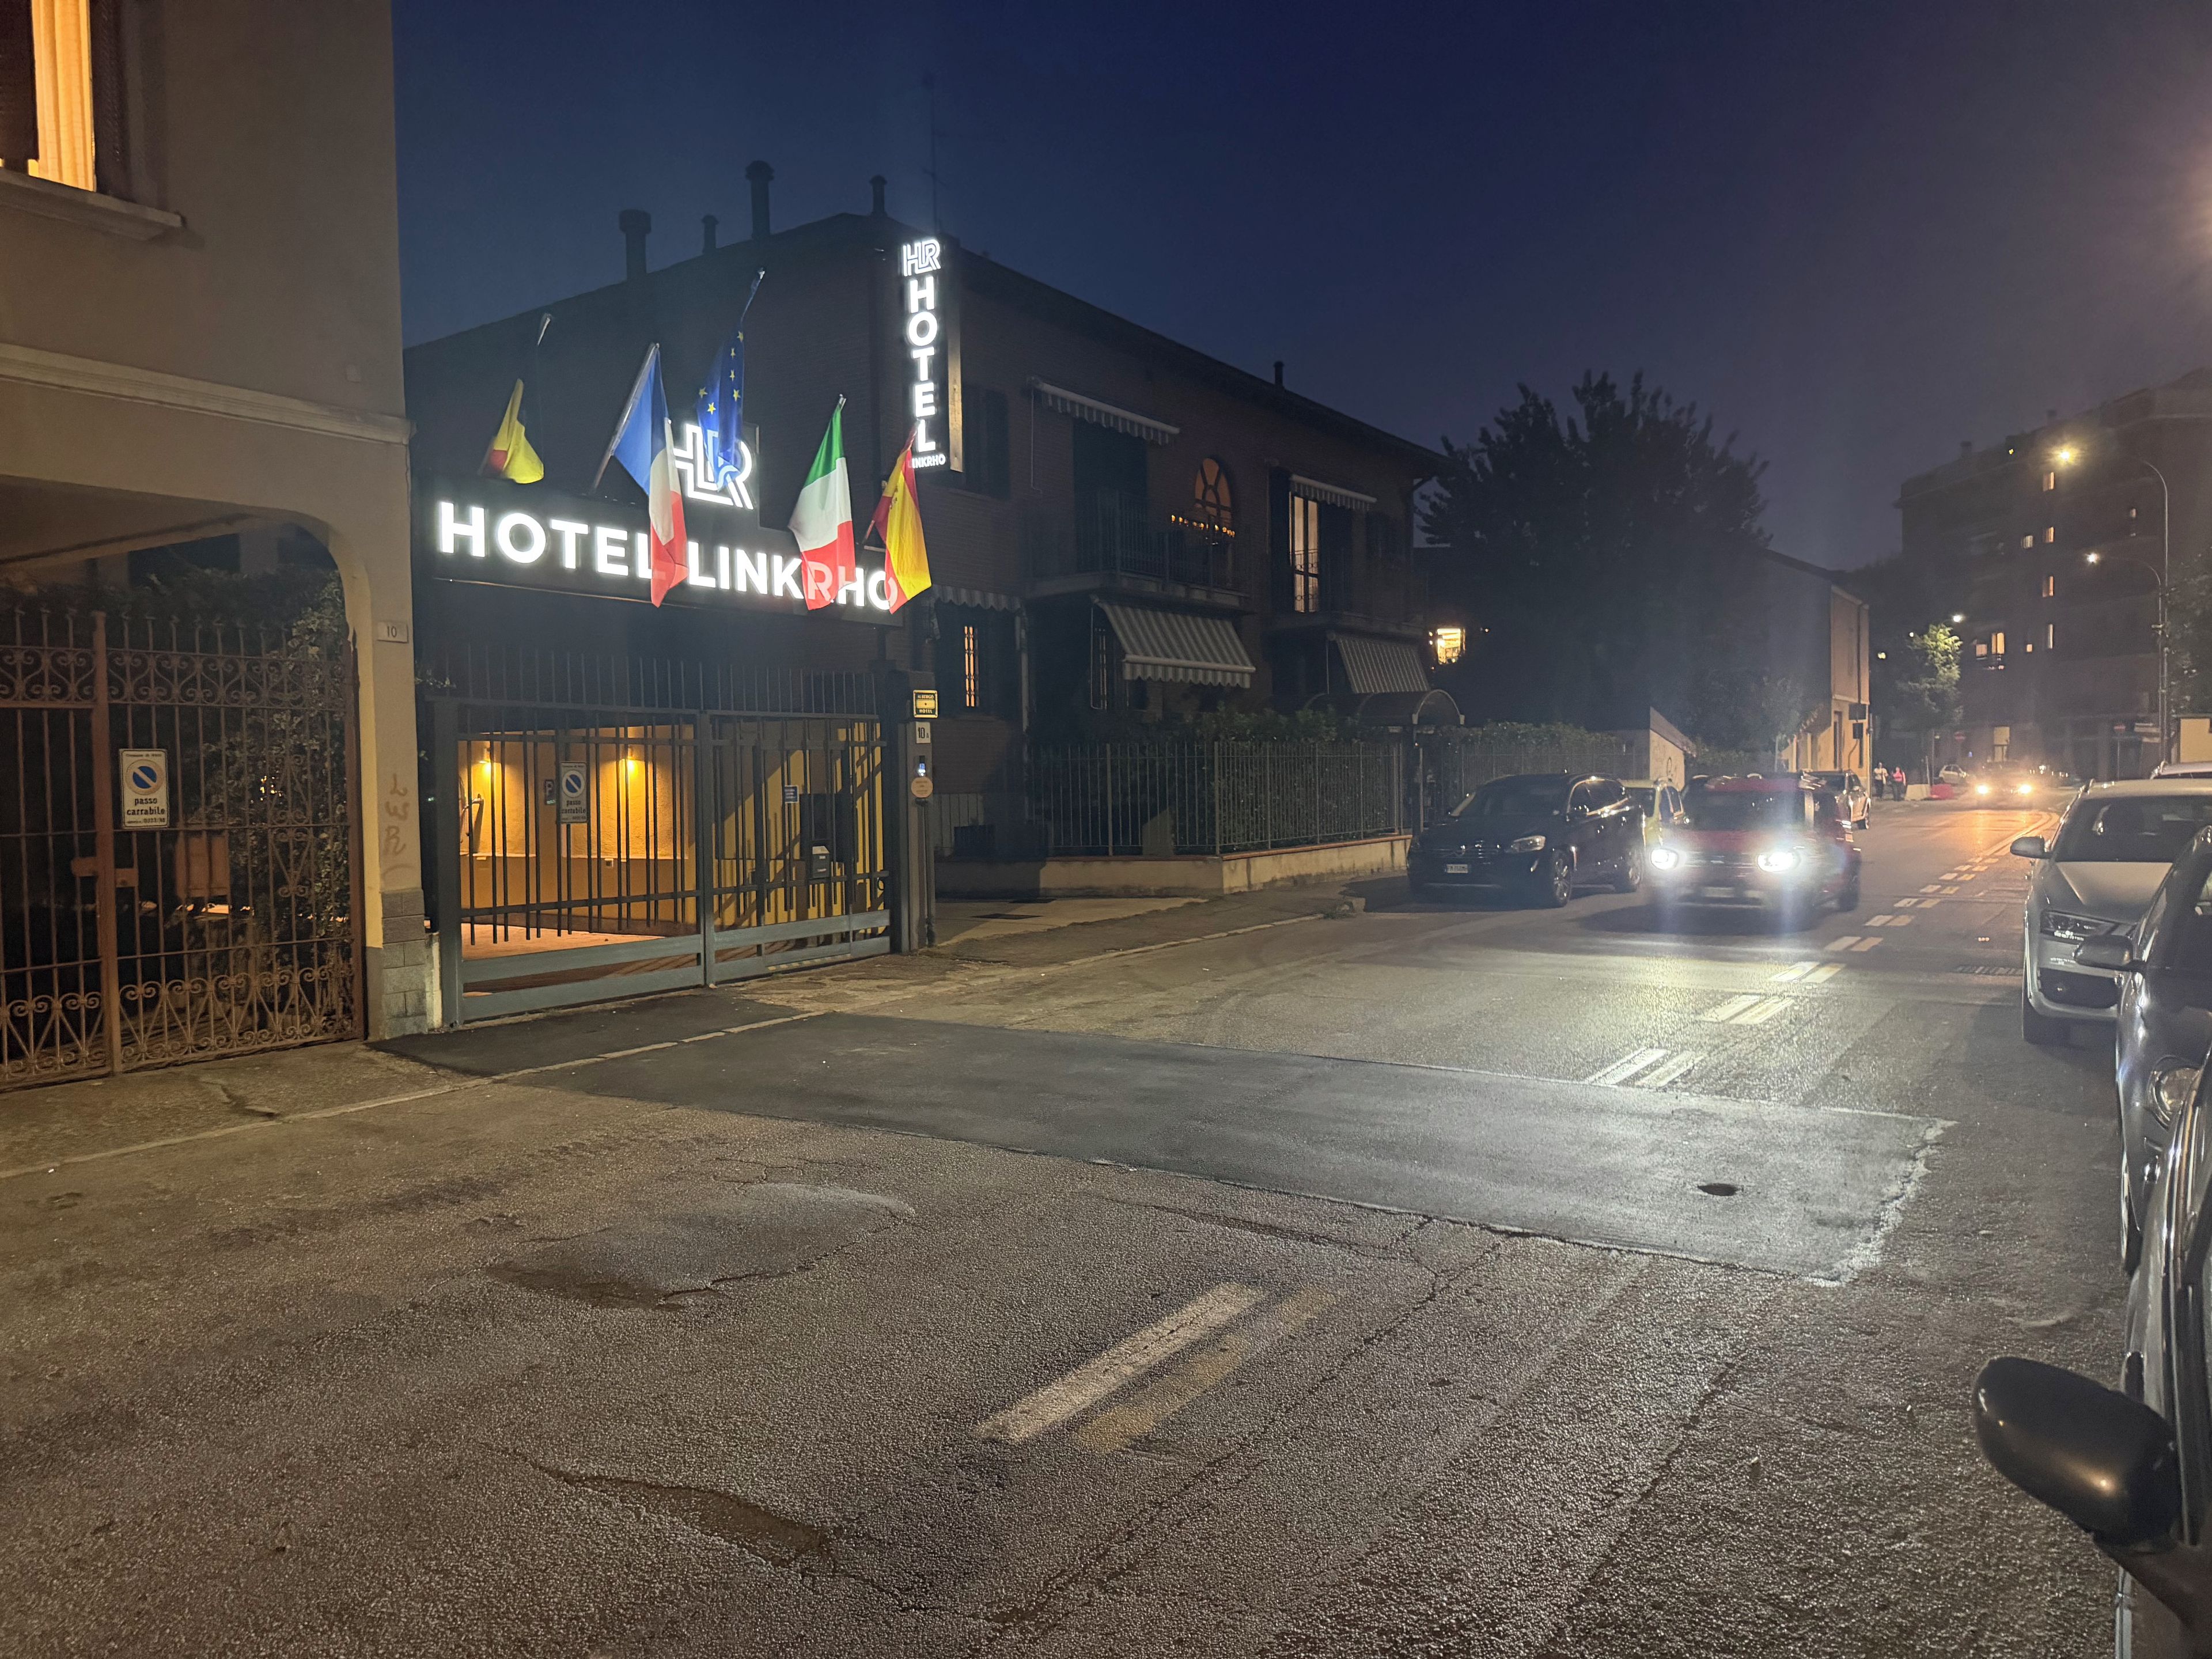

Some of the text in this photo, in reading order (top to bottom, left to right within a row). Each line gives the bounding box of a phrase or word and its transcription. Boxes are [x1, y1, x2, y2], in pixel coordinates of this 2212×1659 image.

[908, 276, 938, 453] HOTEL
[441, 501, 899, 611] HOTEL LINKRHO
[387, 626, 397, 638] 10
[918, 727, 925, 738] 10
[135, 798, 157, 806] passo
[127, 806, 165, 815] carrabile
